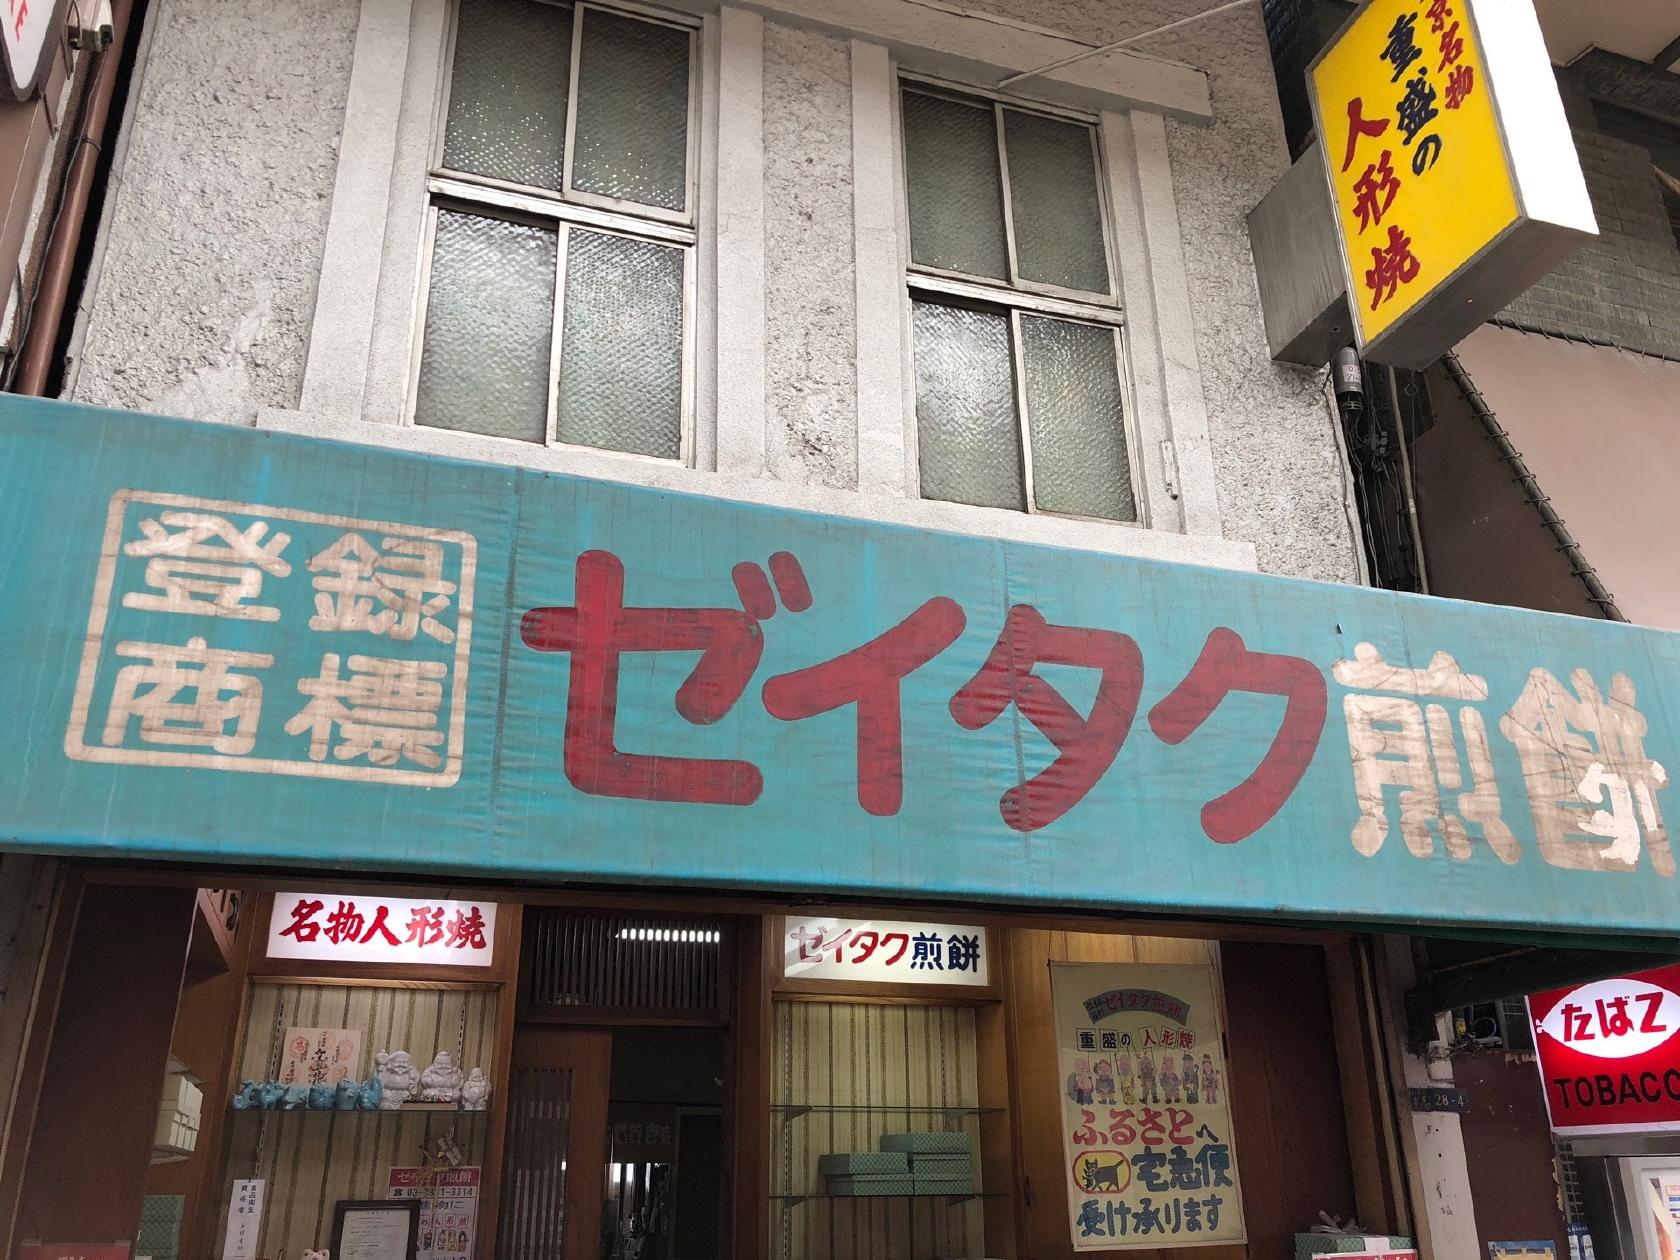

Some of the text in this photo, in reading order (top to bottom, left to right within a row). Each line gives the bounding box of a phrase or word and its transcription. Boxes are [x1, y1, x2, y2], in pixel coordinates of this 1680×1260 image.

[1380, 12, 1443, 176] 重盛の
[1341, 97, 1421, 311] 人形焼
[278, 899, 488, 950] 名物人形焼
[790, 924, 981, 973] ゼイタク煎餅
[1072, 1108, 1219, 1146] ふるさとへ
[1131, 1143, 1234, 1192] 宅急便
[1076, 1193, 1224, 1238] 受け承ります
